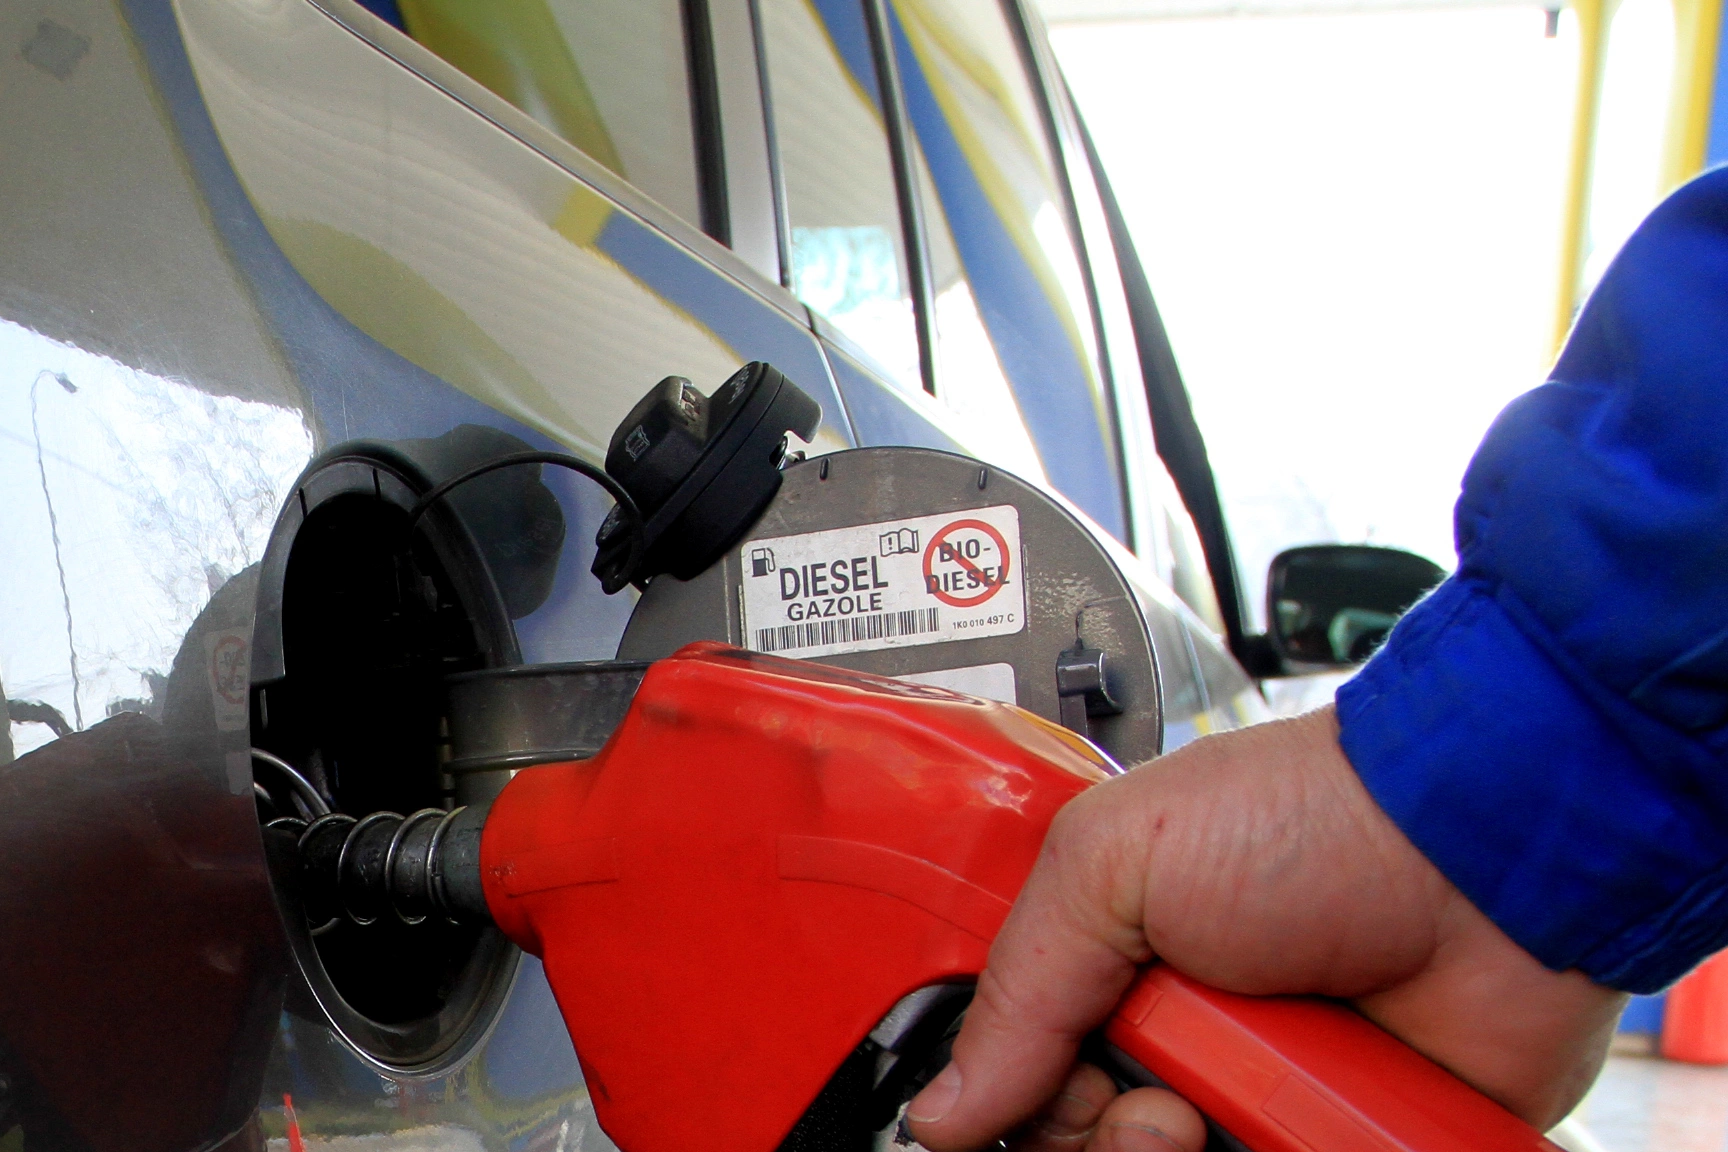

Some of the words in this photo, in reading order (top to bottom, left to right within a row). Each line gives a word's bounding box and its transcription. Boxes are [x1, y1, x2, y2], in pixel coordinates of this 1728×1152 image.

[779, 555, 889, 601] DIESEL
[926, 565, 1010, 594] DIESEL
[786, 592, 883, 621] GAZOLE
[969, 618, 985, 628] 010
[986, 614, 1005, 625] 497
[1006, 612, 1015, 623] C
